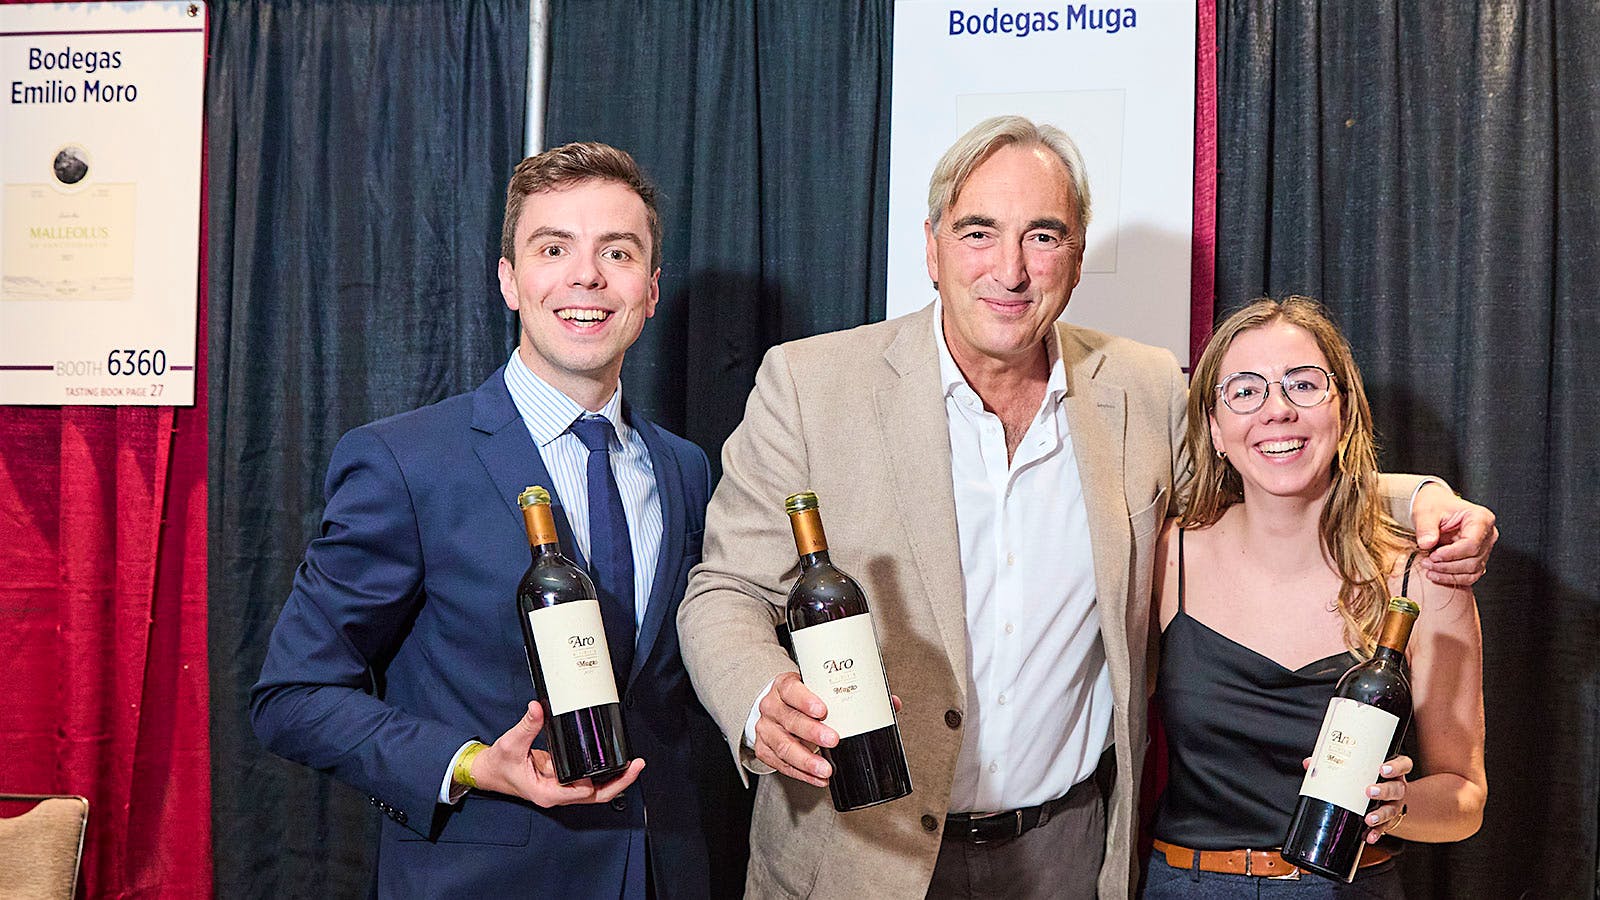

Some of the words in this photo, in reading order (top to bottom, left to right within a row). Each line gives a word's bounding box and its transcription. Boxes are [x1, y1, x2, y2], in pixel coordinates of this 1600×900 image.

[949, 8, 1059, 37] Bodegas
[1066, 4, 1137, 33] Muga
[29, 46, 122, 73] Bodegas
[11, 80, 76, 104] Emilio
[83, 80, 138, 102] Moro
[29, 226, 109, 239] MALLEOLUS
[56, 361, 103, 376] BOOTH
[108, 349, 166, 376] 6360
[65, 387, 99, 397] TASTING
[101, 387, 123, 397] BOOK
[126, 387, 147, 397] PAGE
[150, 384, 165, 397] 27
[568, 635, 595, 648] Aro
[823, 658, 854, 674] Aro
